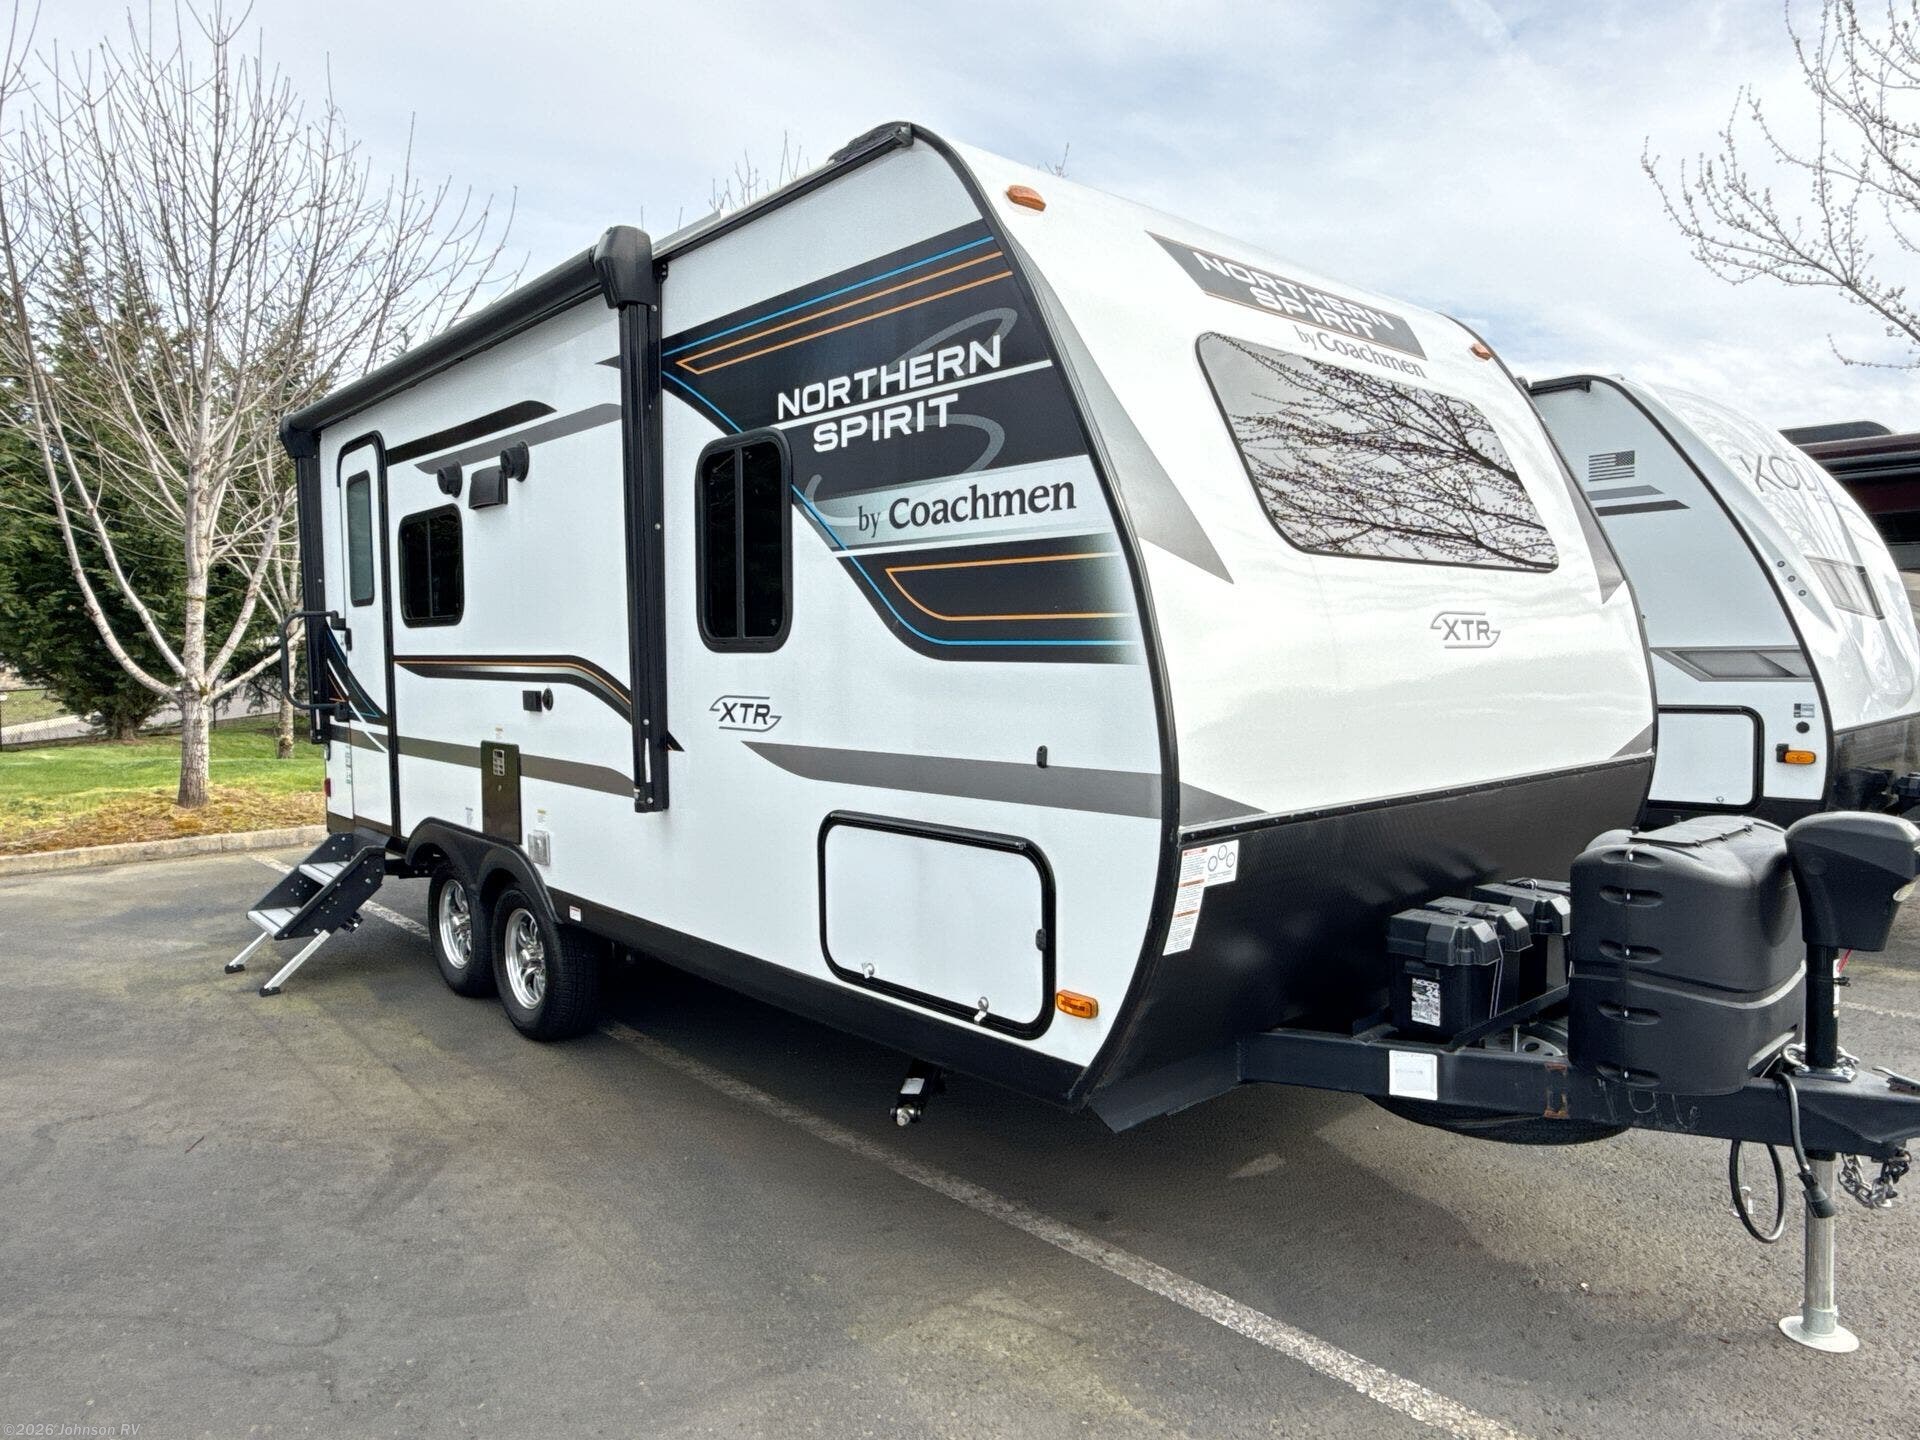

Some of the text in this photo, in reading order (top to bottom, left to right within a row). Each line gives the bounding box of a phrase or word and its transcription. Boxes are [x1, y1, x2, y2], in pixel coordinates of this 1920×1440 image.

[1192, 251, 1395, 331] NORTHERN
[1250, 287, 1375, 340] SPIRIT
[777, 334, 1002, 421] NORTHERN
[1293, 325, 1428, 379] by Coachmen
[813, 393, 959, 453] SPIRIT
[857, 481, 1077, 537] by Coachmen
[1441, 618, 1491, 642] XTR
[718, 702, 771, 725] XTR
